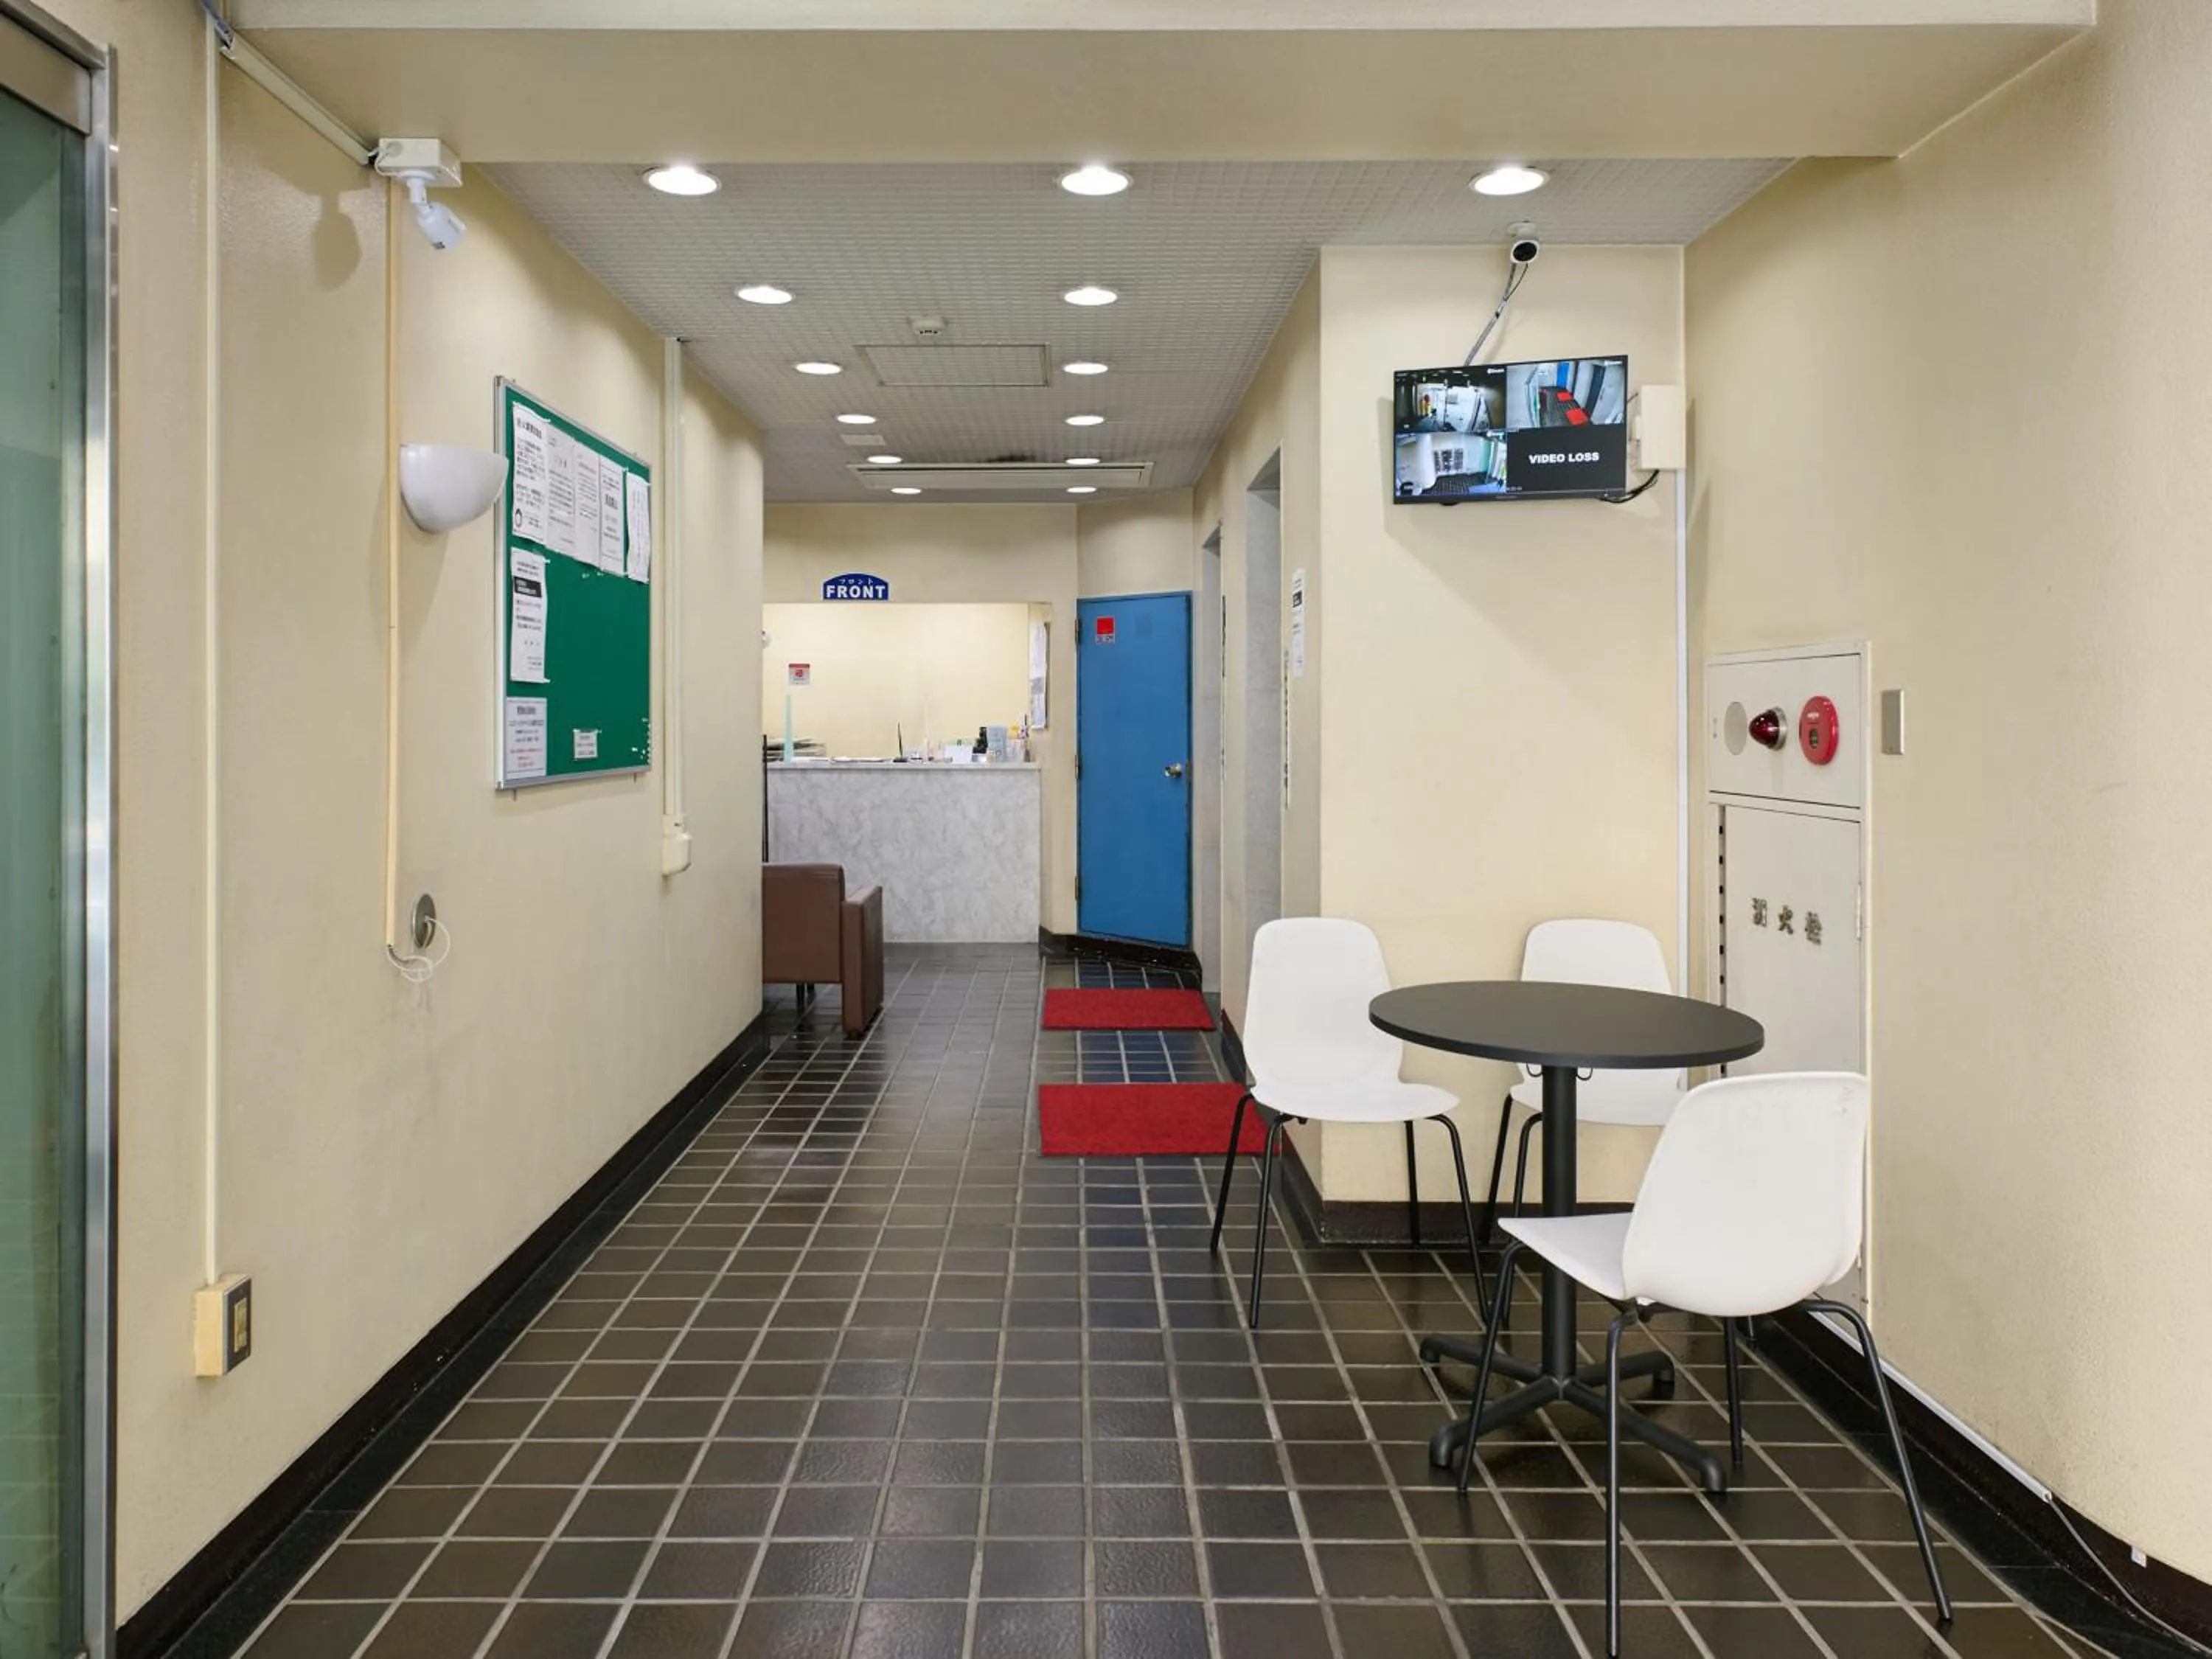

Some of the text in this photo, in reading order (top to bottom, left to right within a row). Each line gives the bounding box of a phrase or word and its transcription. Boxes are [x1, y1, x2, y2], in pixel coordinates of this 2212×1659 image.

[1528, 452, 1599, 464] VIDEO LOSS
[826, 585, 886, 598] FRONT
[1751, 897, 1823, 945] 消火栓
